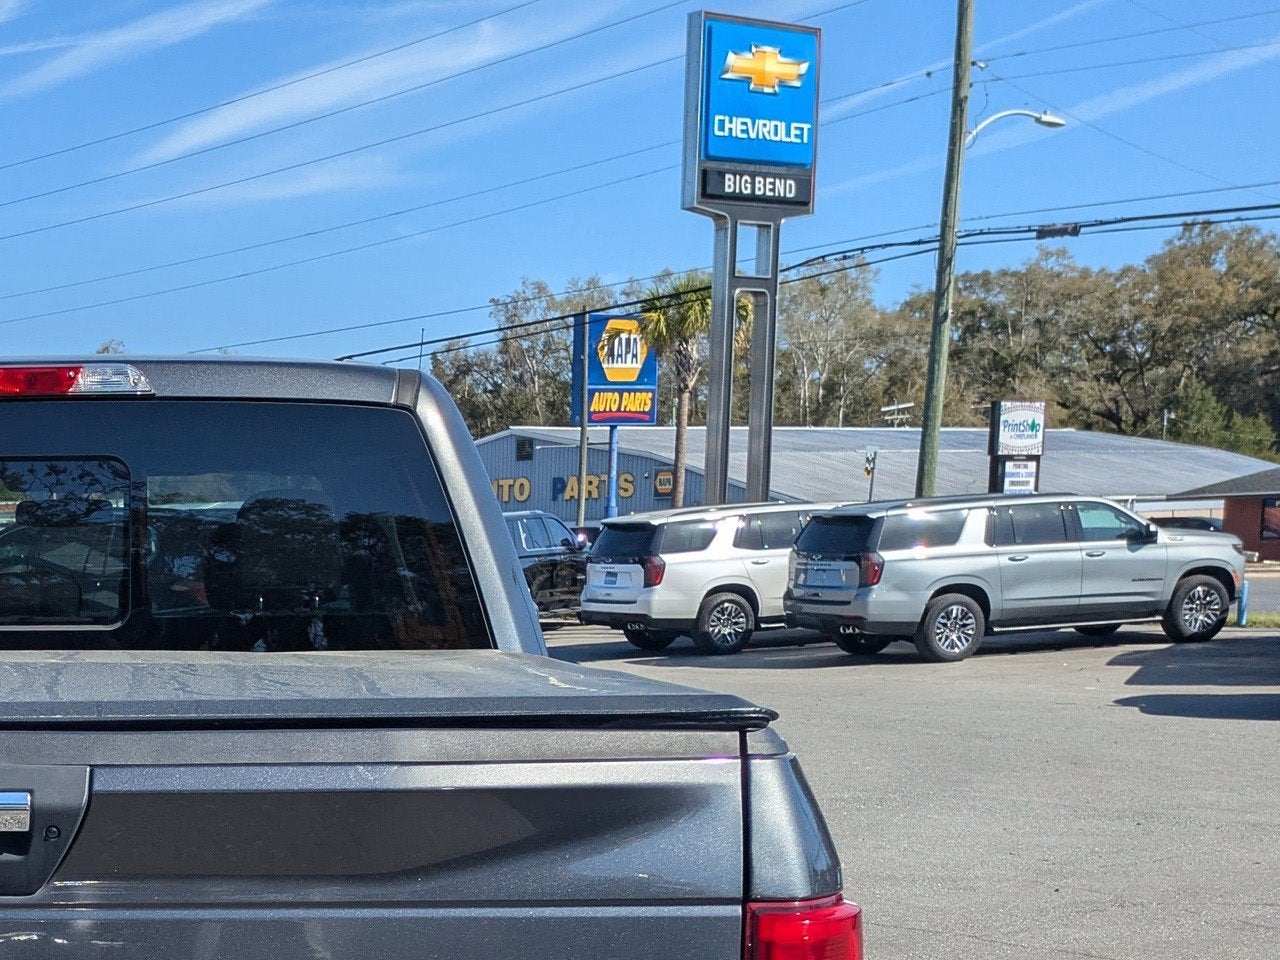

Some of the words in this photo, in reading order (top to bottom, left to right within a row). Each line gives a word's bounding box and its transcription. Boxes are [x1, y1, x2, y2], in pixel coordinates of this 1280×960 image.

[713, 114, 812, 144] CHEVROLET
[724, 173, 752, 195] BIG
[754, 176, 797, 198] BEND
[606, 334, 640, 365] NAPA
[589, 391, 620, 412] AUTO
[620, 391, 653, 412] PARTS
